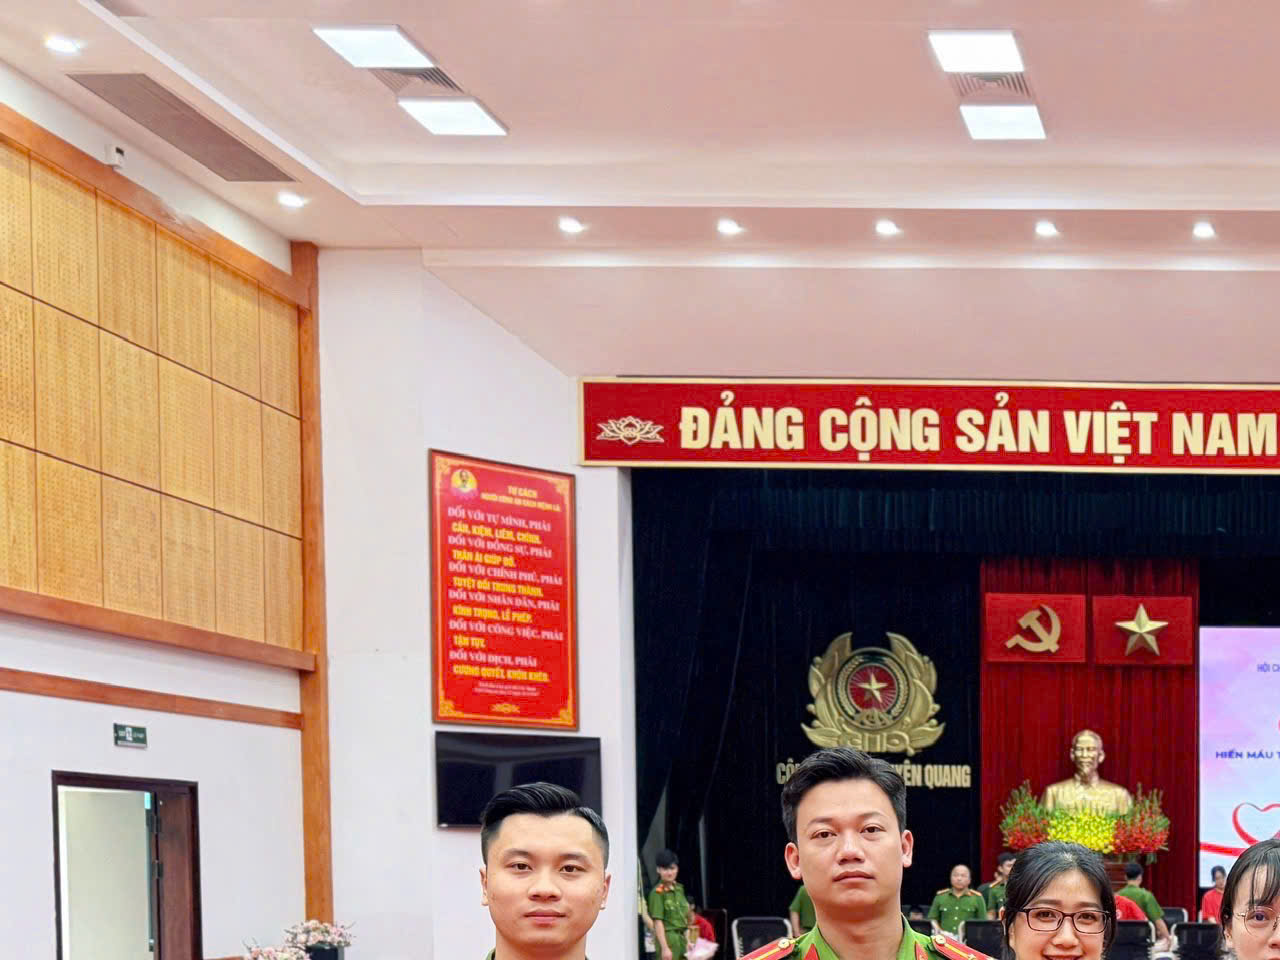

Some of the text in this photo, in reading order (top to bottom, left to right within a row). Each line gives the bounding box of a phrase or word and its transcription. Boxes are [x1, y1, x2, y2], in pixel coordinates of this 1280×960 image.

[679, 391, 804, 449] ĐẢNG
[819, 396, 940, 461] CỘNG
[955, 392, 1050, 453] SẢN
[1063, 401, 1158, 464] VIỆT
[1172, 413, 1277, 456] NAM
[1216, 748, 1243, 759] HIẾN
[1247, 748, 1273, 759] MÁU
[924, 764, 971, 789] QUANG
